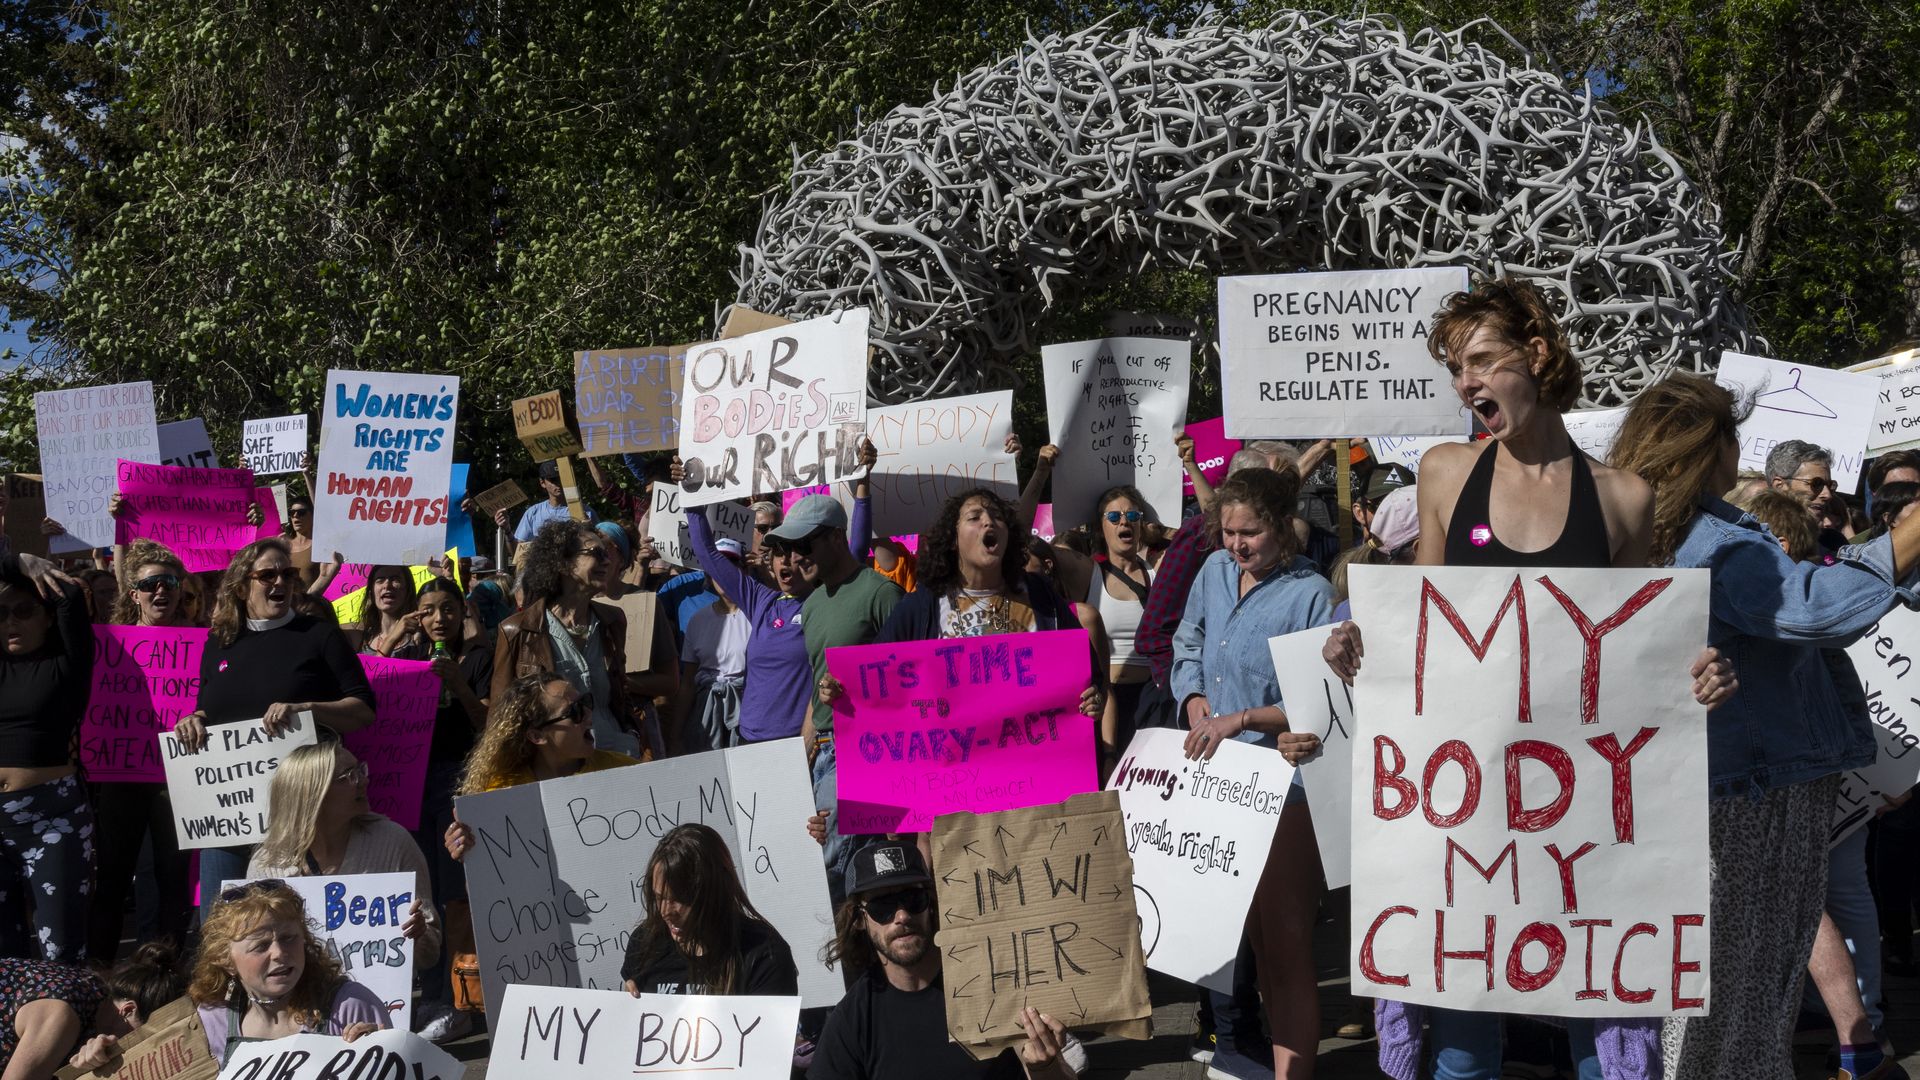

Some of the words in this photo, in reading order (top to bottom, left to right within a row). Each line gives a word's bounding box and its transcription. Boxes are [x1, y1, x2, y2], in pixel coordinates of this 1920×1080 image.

[1253, 286, 1421, 317] PREGNANCY
[1126, 325, 1191, 336] JACKSON
[1268, 323, 1340, 343] BEGINS
[1351, 321, 1403, 340] WITH
[1412, 320, 1428, 339] A
[691, 336, 804, 394] OUR
[1072, 358, 1084, 373] IF
[1306, 350, 1390, 373] PENIS.
[37, 392, 69, 415] BANS
[74, 390, 96, 410] OFF
[100, 388, 120, 408] OUR
[122, 384, 152, 406] BODIES
[336, 383, 454, 421] WOMEN'S
[576, 390, 646, 418] WAR
[1082, 381, 1093, 402] MY
[1100, 377, 1172, 393] REPRODUCTIVE
[1098, 393, 1140, 411] RIGHTS
[1259, 380, 1369, 401] REGULATE
[1379, 379, 1435, 400] THAT.
[38, 416, 66, 437] BANS
[70, 413, 88, 433] OFF
[93, 411, 112, 430] OUR
[118, 407, 151, 427] BODIES
[515, 408, 528, 428] MY
[528, 392, 561, 425] BODY
[832, 402, 855, 419] ARE
[917, 402, 998, 447] BODY
[1091, 416, 1116, 434] CAN
[1126, 416, 1143, 428] I
[246, 424, 258, 435] YOU
[259, 423, 272, 434] CAN
[275, 420, 290, 432] ONLY
[292, 418, 306, 430] BAN
[354, 423, 445, 452] RIGHTS
[579, 417, 651, 451] THE
[1879, 420, 1897, 434] MY
[41, 438, 68, 458] BANS
[72, 434, 86, 453] OFF
[93, 432, 114, 451] OUR
[117, 428, 150, 449] BODIES
[244, 436, 274, 454] SAFE
[535, 431, 576, 453] CHOICE
[118, 462, 153, 484] GUNS
[155, 467, 183, 485] NOW
[184, 470, 216, 485] HAVE
[217, 472, 249, 488] MORE
[366, 450, 411, 472] ARE
[680, 446, 741, 494] OUR
[46, 476, 90, 498] BANS
[327, 472, 413, 498] HUMAN
[174, 496, 211, 511] THAN
[348, 495, 448, 526] RIGHTS!
[715, 502, 750, 534] PLAY
[123, 523, 139, 538] IN
[132, 632, 195, 670] CAN'T
[1414, 573, 1675, 726] MY
[99, 672, 200, 698] ABORTIONS
[858, 653, 920, 700] IT'S
[935, 642, 1037, 688] TIME
[89, 704, 130, 729] CAN
[911, 698, 951, 719] TO
[858, 707, 1068, 764] OVARY-ACT
[82, 735, 140, 769] SAFE
[195, 757, 279, 786] POLITICS
[925, 768, 981, 791] BODY
[1114, 756, 1188, 802] Wyoming:
[1191, 757, 1285, 816] freedom
[1373, 726, 1661, 846] BODY
[216, 787, 254, 808] WITH
[944, 791, 971, 808] MY
[181, 811, 252, 841] WOMEN'S
[754, 845, 780, 882] a
[1178, 831, 1240, 877] right.
[974, 864, 1025, 916] IM
[1042, 852, 1092, 904] WI
[1446, 835, 1600, 914] MY
[324, 881, 412, 932] Bear
[987, 921, 1092, 994] HER
[1359, 904, 1705, 1011] CHOICE
[521, 1005, 601, 1065] MY
[634, 1011, 762, 1069] BODY
